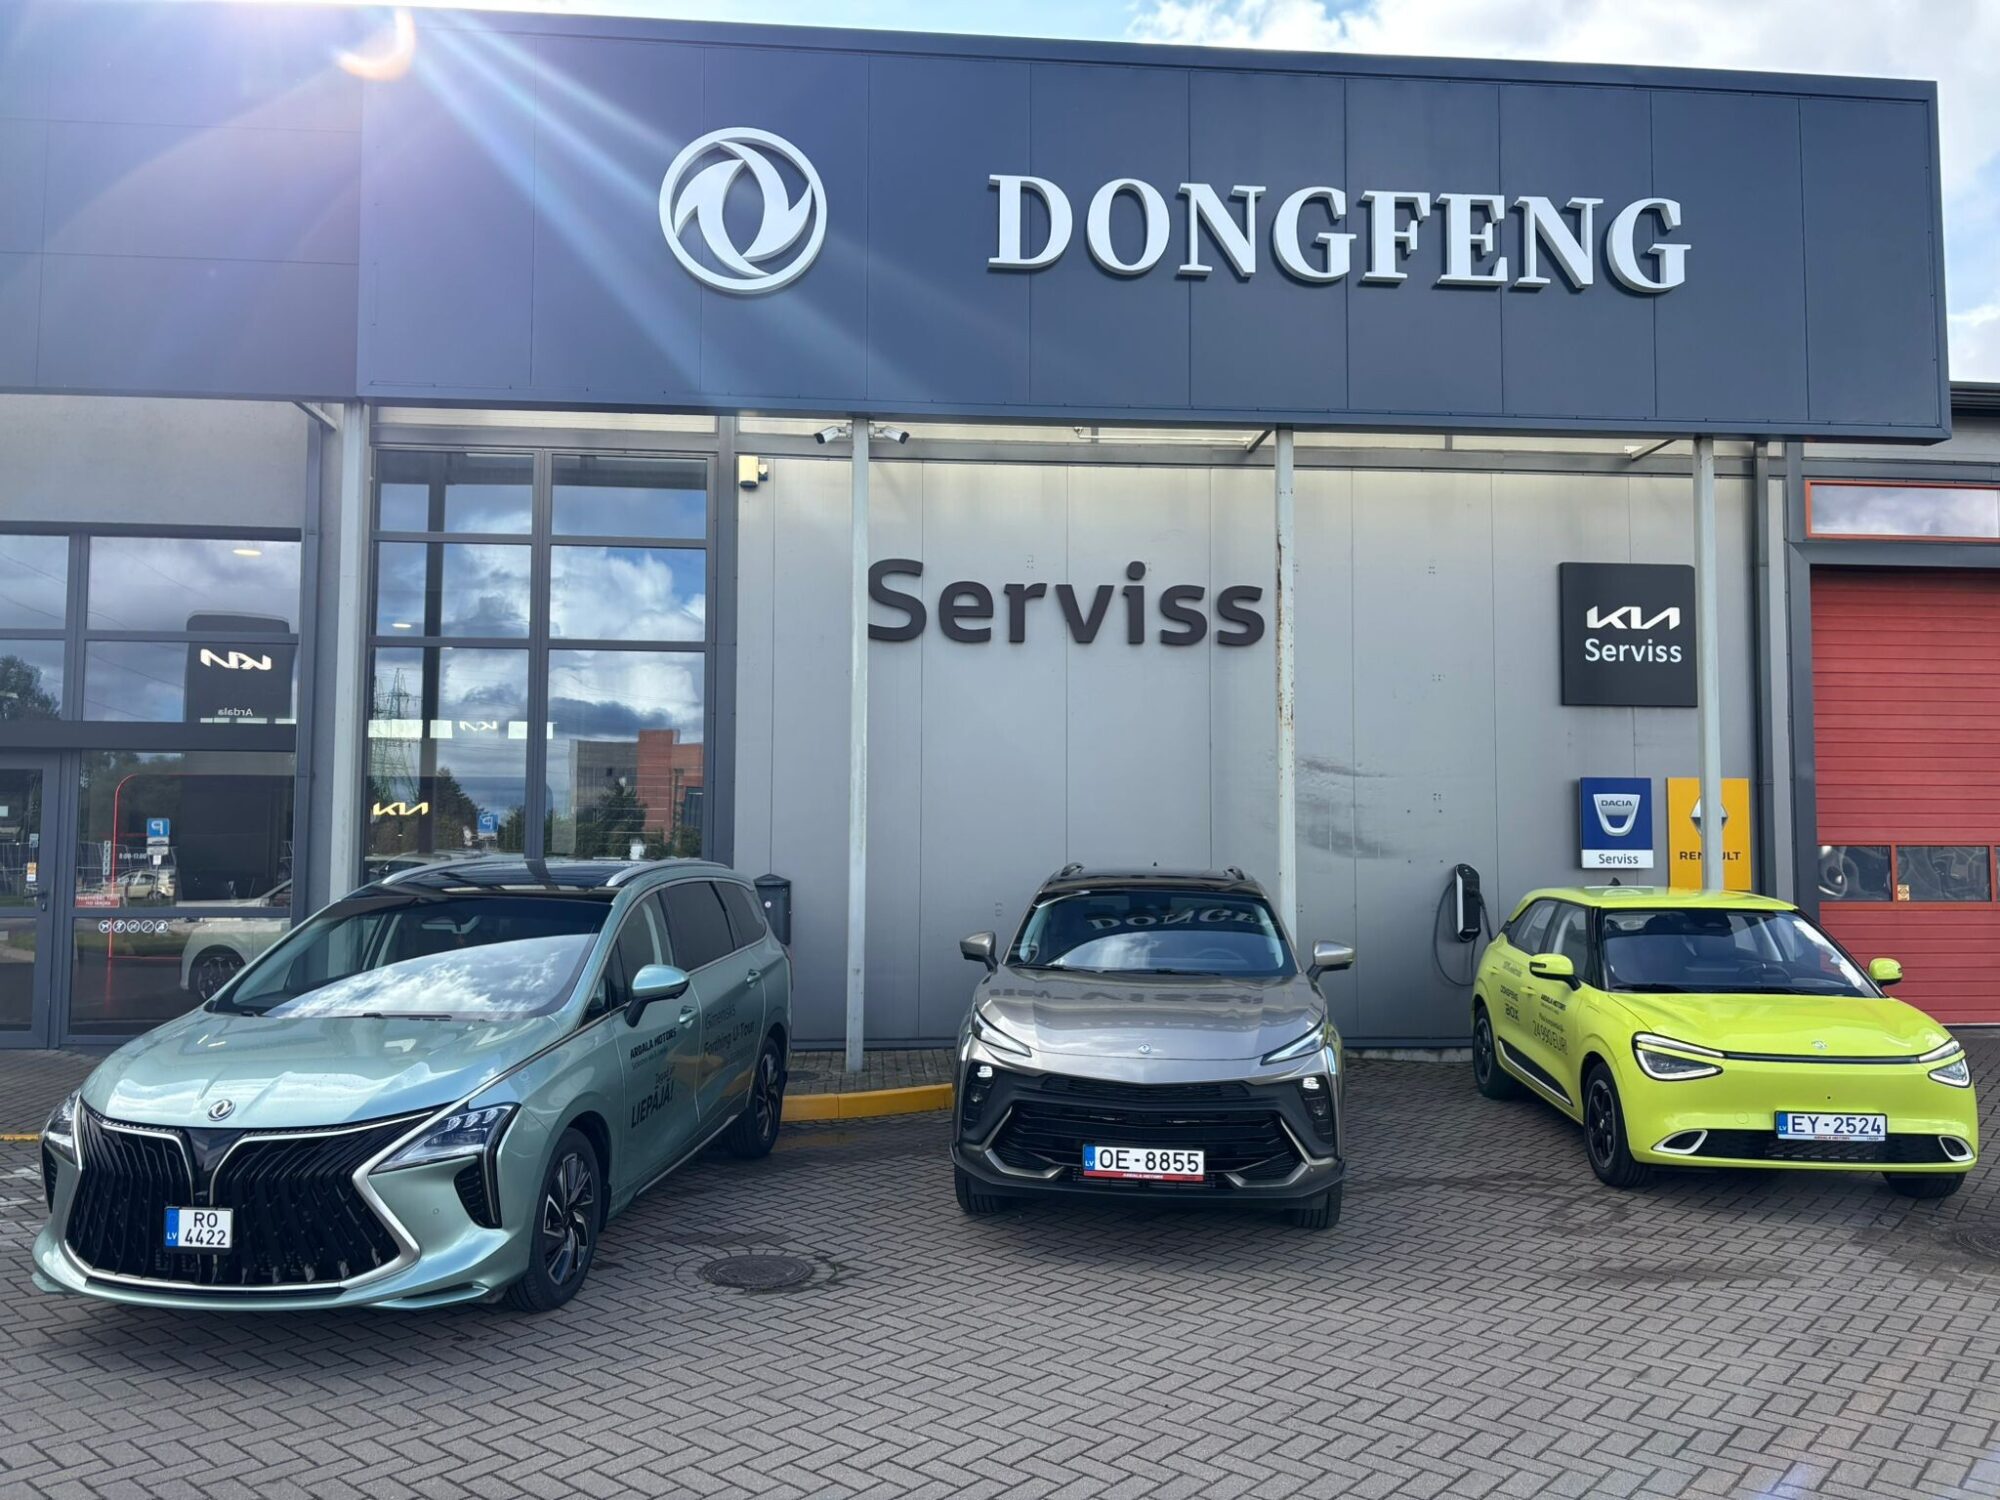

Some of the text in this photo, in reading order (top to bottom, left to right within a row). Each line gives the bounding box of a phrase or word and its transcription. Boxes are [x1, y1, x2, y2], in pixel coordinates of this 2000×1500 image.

[988, 173, 1692, 294] DONGFENG
[868, 558, 1265, 646] Serviss
[1586, 605, 1680, 630] KIA
[1585, 638, 1682, 662] Serviss
[373, 802, 428, 815] KIA
[1598, 853, 1639, 864] Serviss
[1680, 851, 1741, 860] RELT
[1791, 1115, 1882, 1135] EY-2524
[1100, 1149, 1199, 1172] OE-8855
[193, 1211, 218, 1228] RO
[167, 1232, 178, 1240] LV
[184, 1228, 226, 1246] 4422
